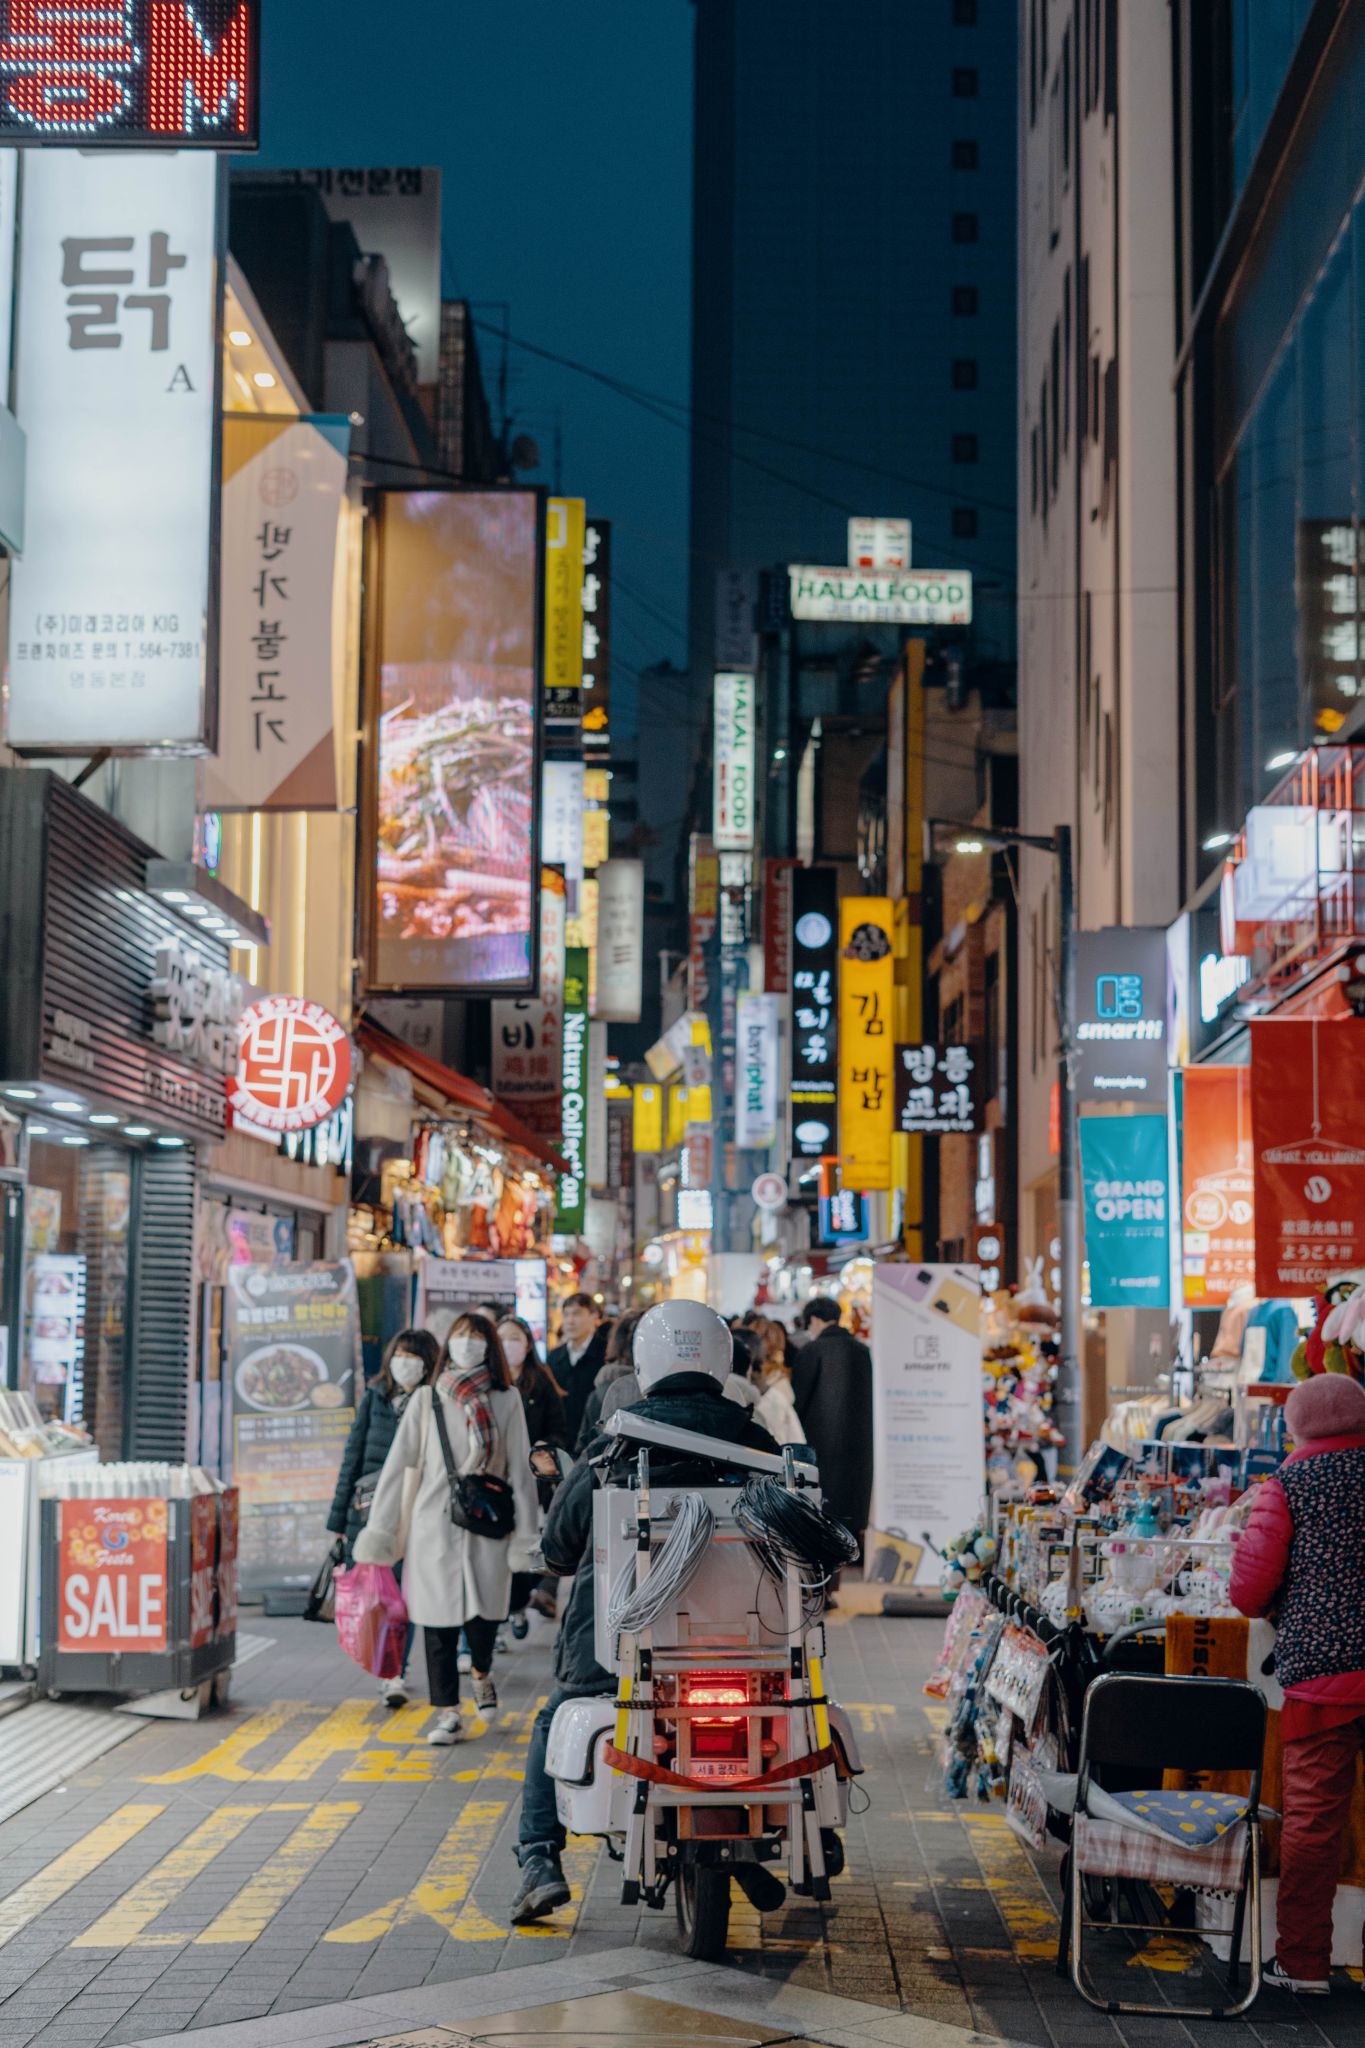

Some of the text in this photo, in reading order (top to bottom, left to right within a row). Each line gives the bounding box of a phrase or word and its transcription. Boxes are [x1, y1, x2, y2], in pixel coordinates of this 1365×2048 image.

[60, 231, 187, 351] 닭
[166, 363, 196, 392] A
[561, 1012, 586, 1090] Nature
[851, 990, 888, 1110] 김밥
[902, 1044, 975, 1083] 명동
[902, 1084, 975, 1119] 교자
[1094, 1180, 1165, 1198] GRAND
[1095, 1198, 1165, 1221] OPEN
[94, 1507, 135, 1523] Korea
[64, 1574, 163, 1638] SALE
[697, 1763, 738, 1776] 서울 광진
